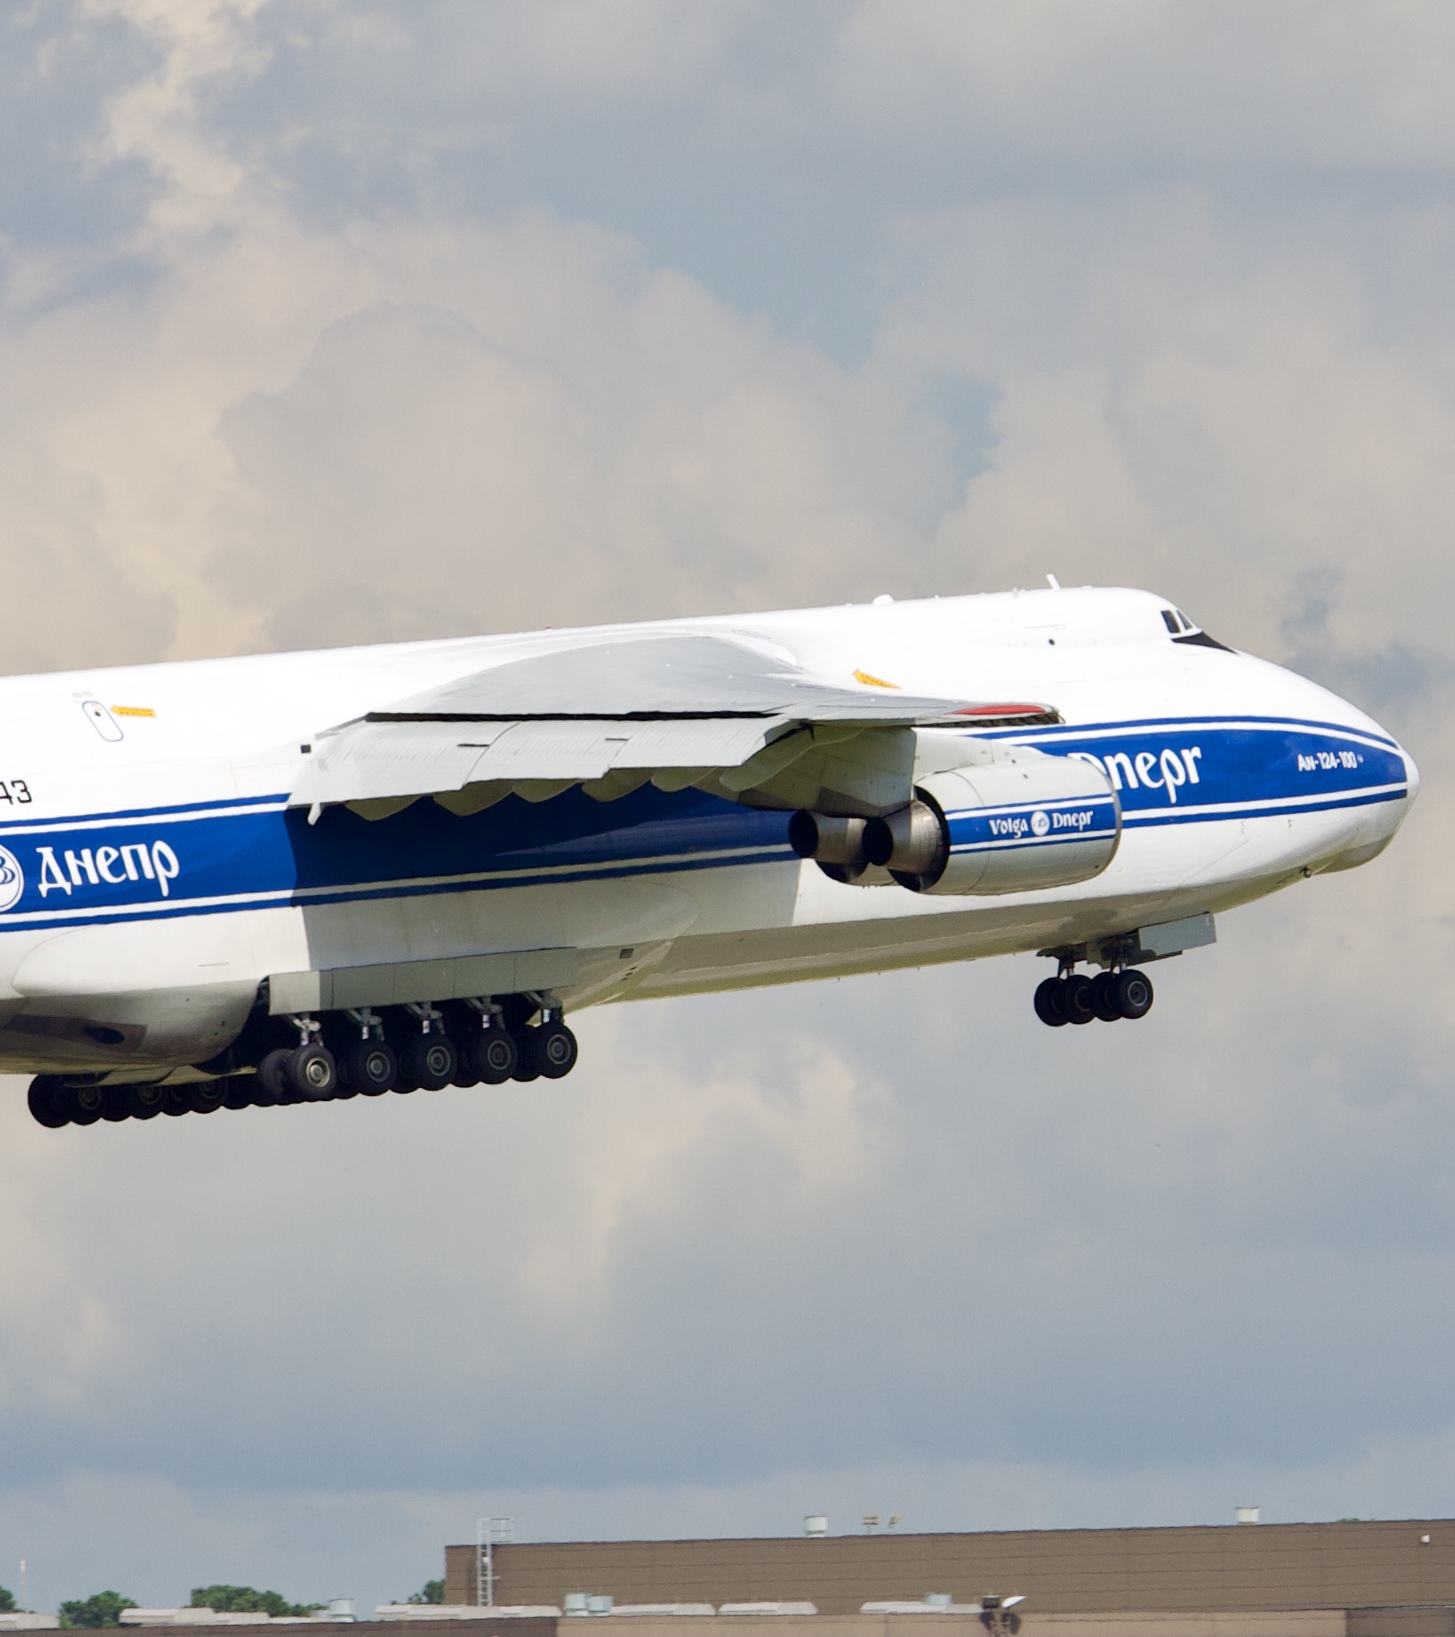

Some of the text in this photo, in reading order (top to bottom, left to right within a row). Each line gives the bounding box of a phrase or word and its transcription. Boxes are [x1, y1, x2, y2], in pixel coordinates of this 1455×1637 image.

[989, 811, 1093, 838] Volga Dnepr
[36, 840, 179, 897] Днепр
